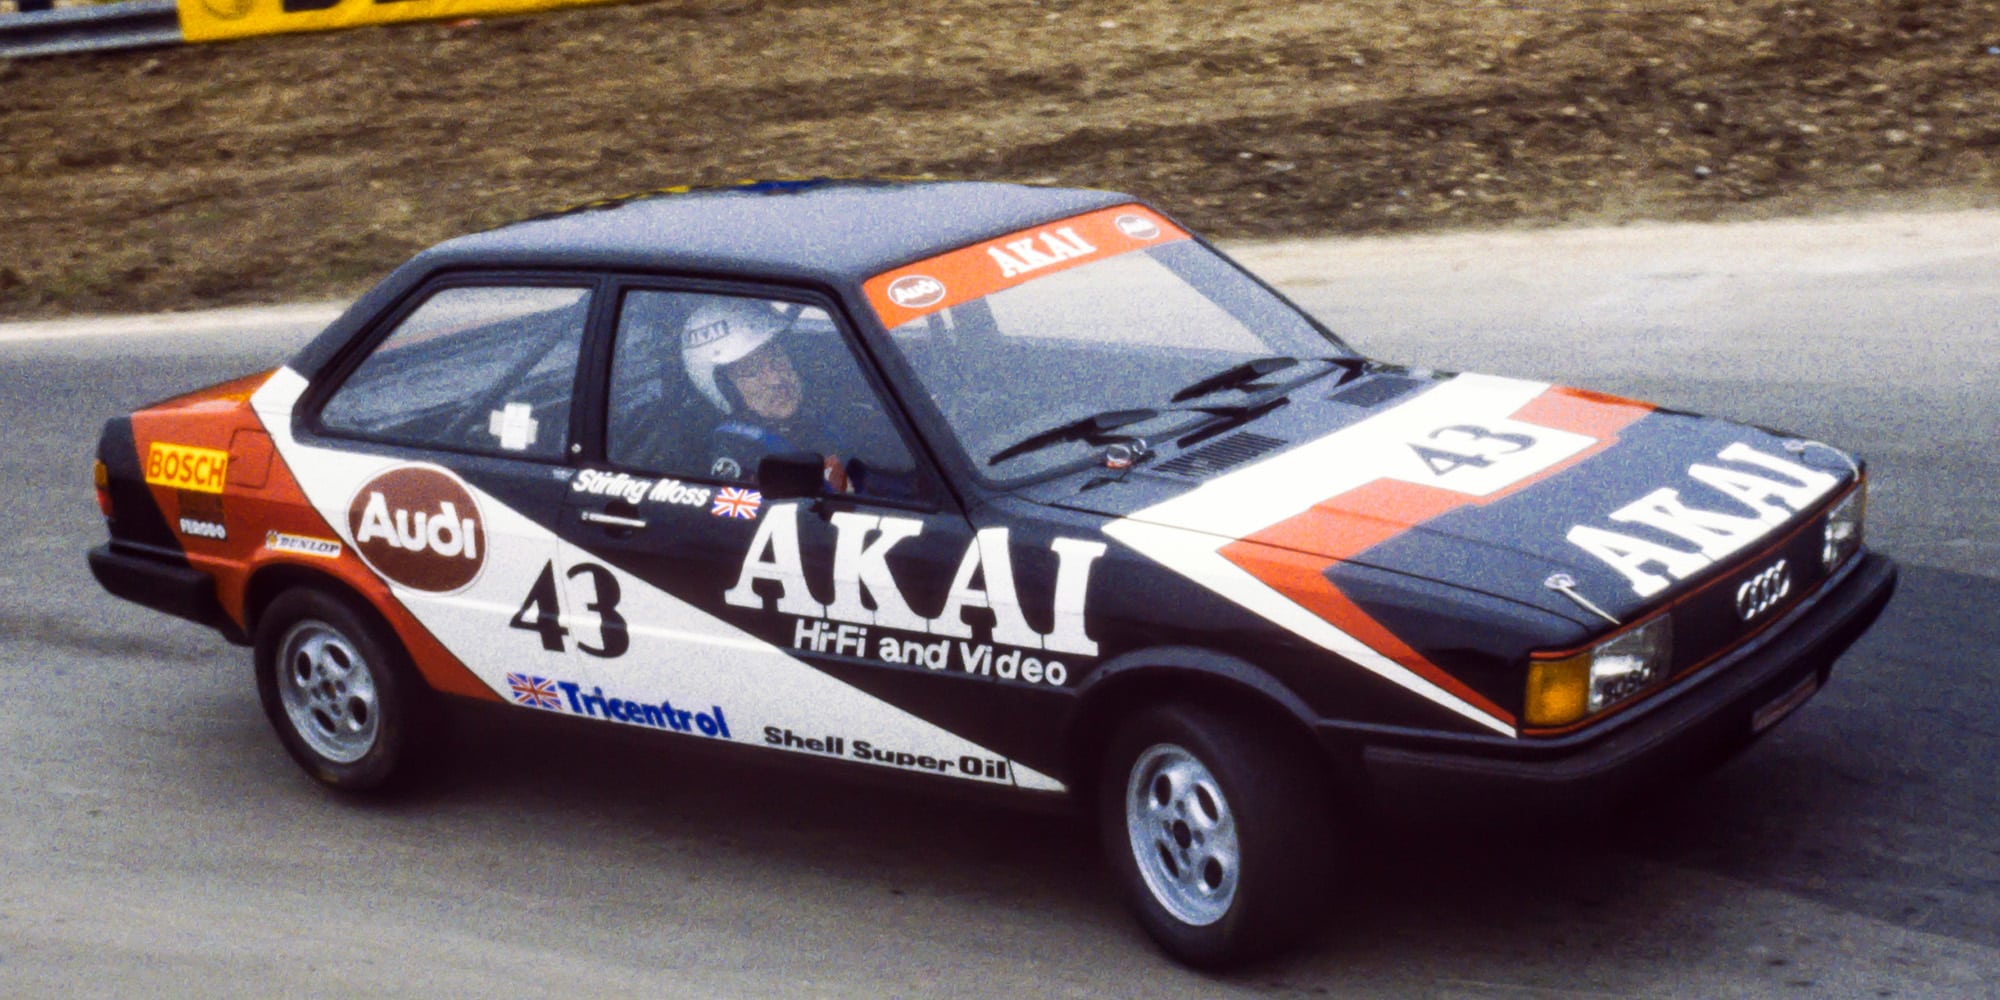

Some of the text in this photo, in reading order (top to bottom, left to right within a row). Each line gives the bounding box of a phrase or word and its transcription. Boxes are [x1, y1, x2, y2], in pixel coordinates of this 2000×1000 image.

[987, 226, 1097, 278] AKAI
[147, 450, 227, 488] BOSCH
[1406, 424, 1537, 476] 43
[572, 468, 711, 507] Stirling Moss
[279, 534, 341, 554] DUNLOP
[356, 490, 478, 560] Audi
[1566, 442, 1840, 598] AKAI
[724, 502, 1108, 657] AKAI
[509, 557, 630, 659] 43
[879, 636, 951, 670] and
[960, 641, 1067, 686] Video
[557, 681, 732, 739] Tricentrol
[763, 725, 1007, 780] Shell Super Oil
